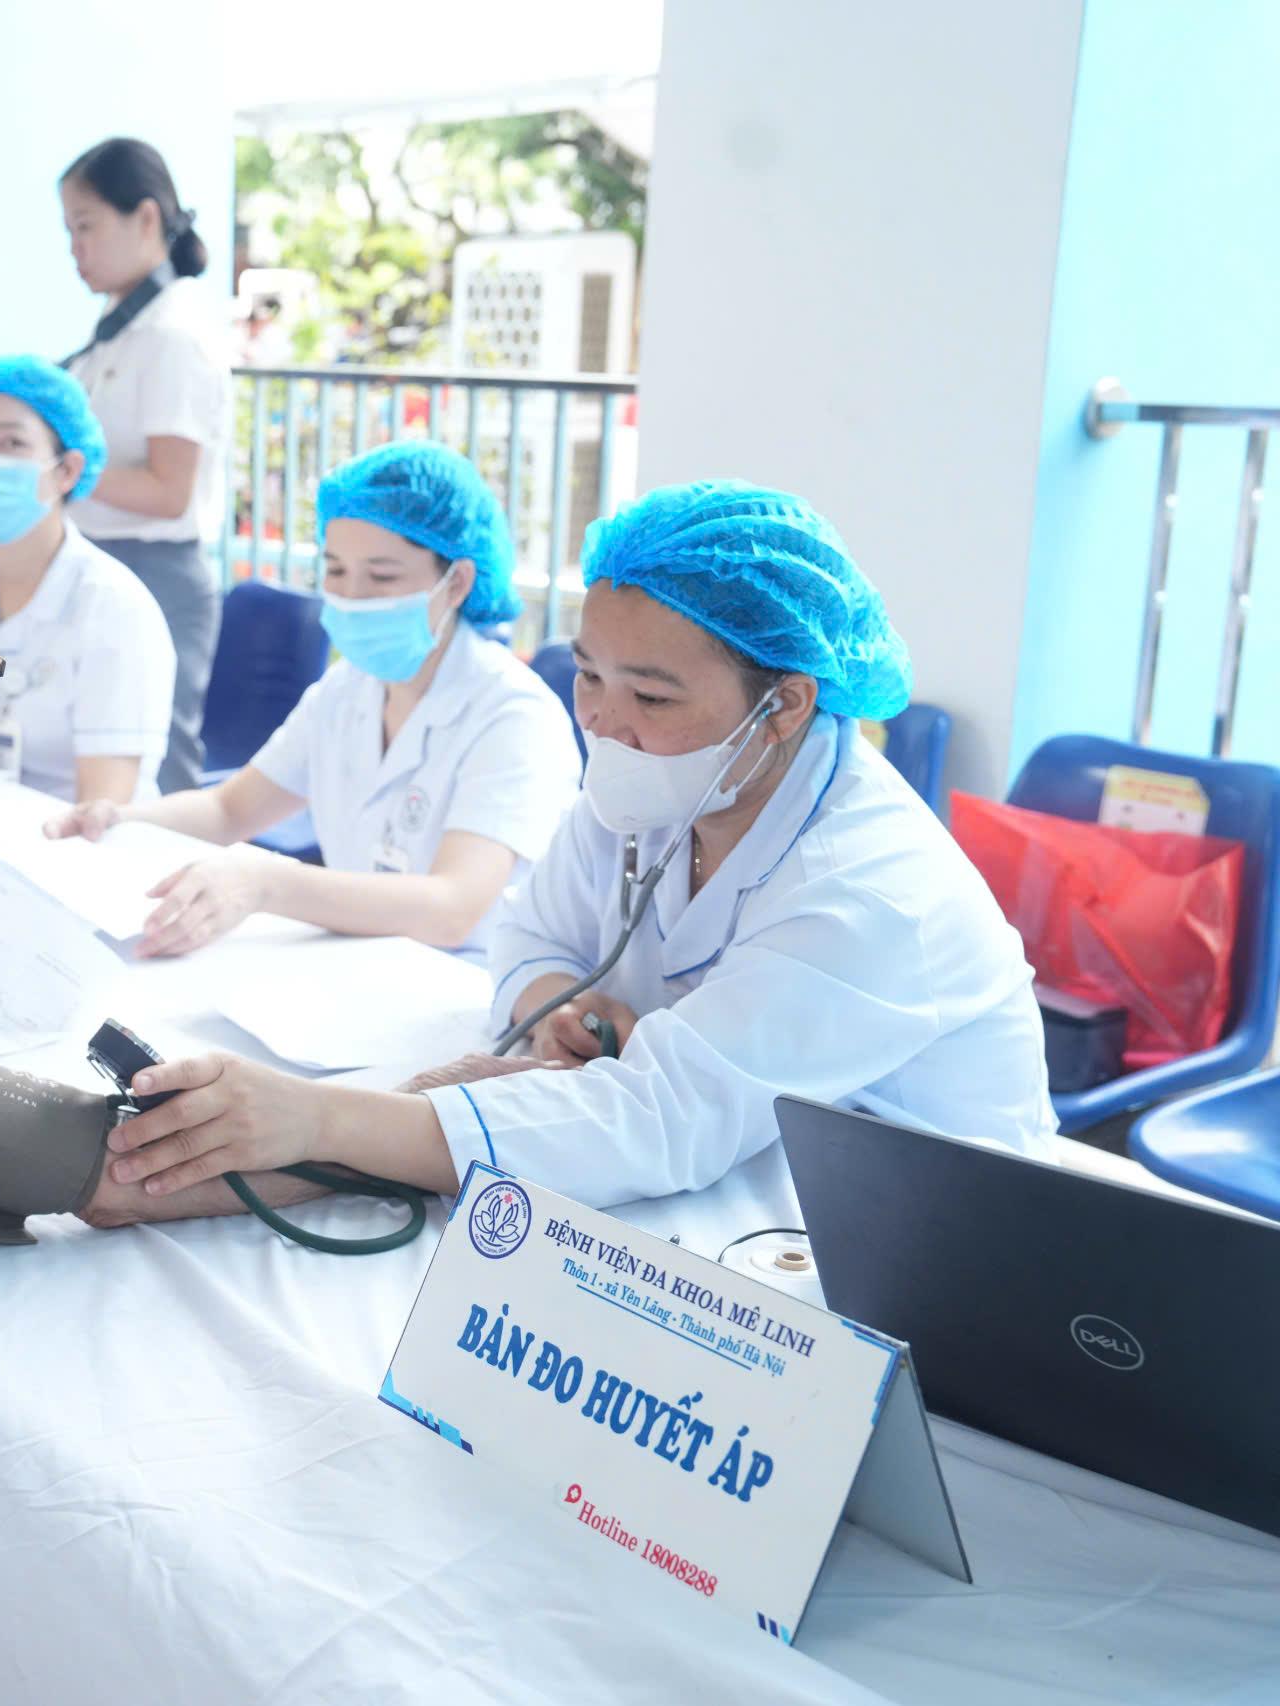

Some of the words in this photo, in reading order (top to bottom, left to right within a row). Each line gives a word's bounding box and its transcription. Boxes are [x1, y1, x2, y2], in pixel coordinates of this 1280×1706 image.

[543, 1218, 595, 1255] BỆNH
[597, 1246, 642, 1276] VIỆN
[640, 1263, 667, 1290] ĐA
[670, 1276, 724, 1317] KHOA
[727, 1302, 761, 1332] MÊ
[761, 1318, 816, 1358] LINH
[563, 1257, 590, 1282] Thôn
[590, 1272, 598, 1286] 1
[620, 1285, 641, 1307] Yên
[679, 1313, 716, 1344] Thành
[716, 1335, 746, 1355] phố
[742, 1343, 761, 1365] Hà
[762, 1353, 786, 1378] Nội
[1079, 1328, 1137, 1357] DELL
[527, 1340, 583, 1404] ĐO
[581, 1369, 714, 1472] HUYẾT
[707, 1425, 774, 1502] ÁP
[577, 1500, 639, 1552] Hotline
[640, 1539, 719, 1597] 18008288
